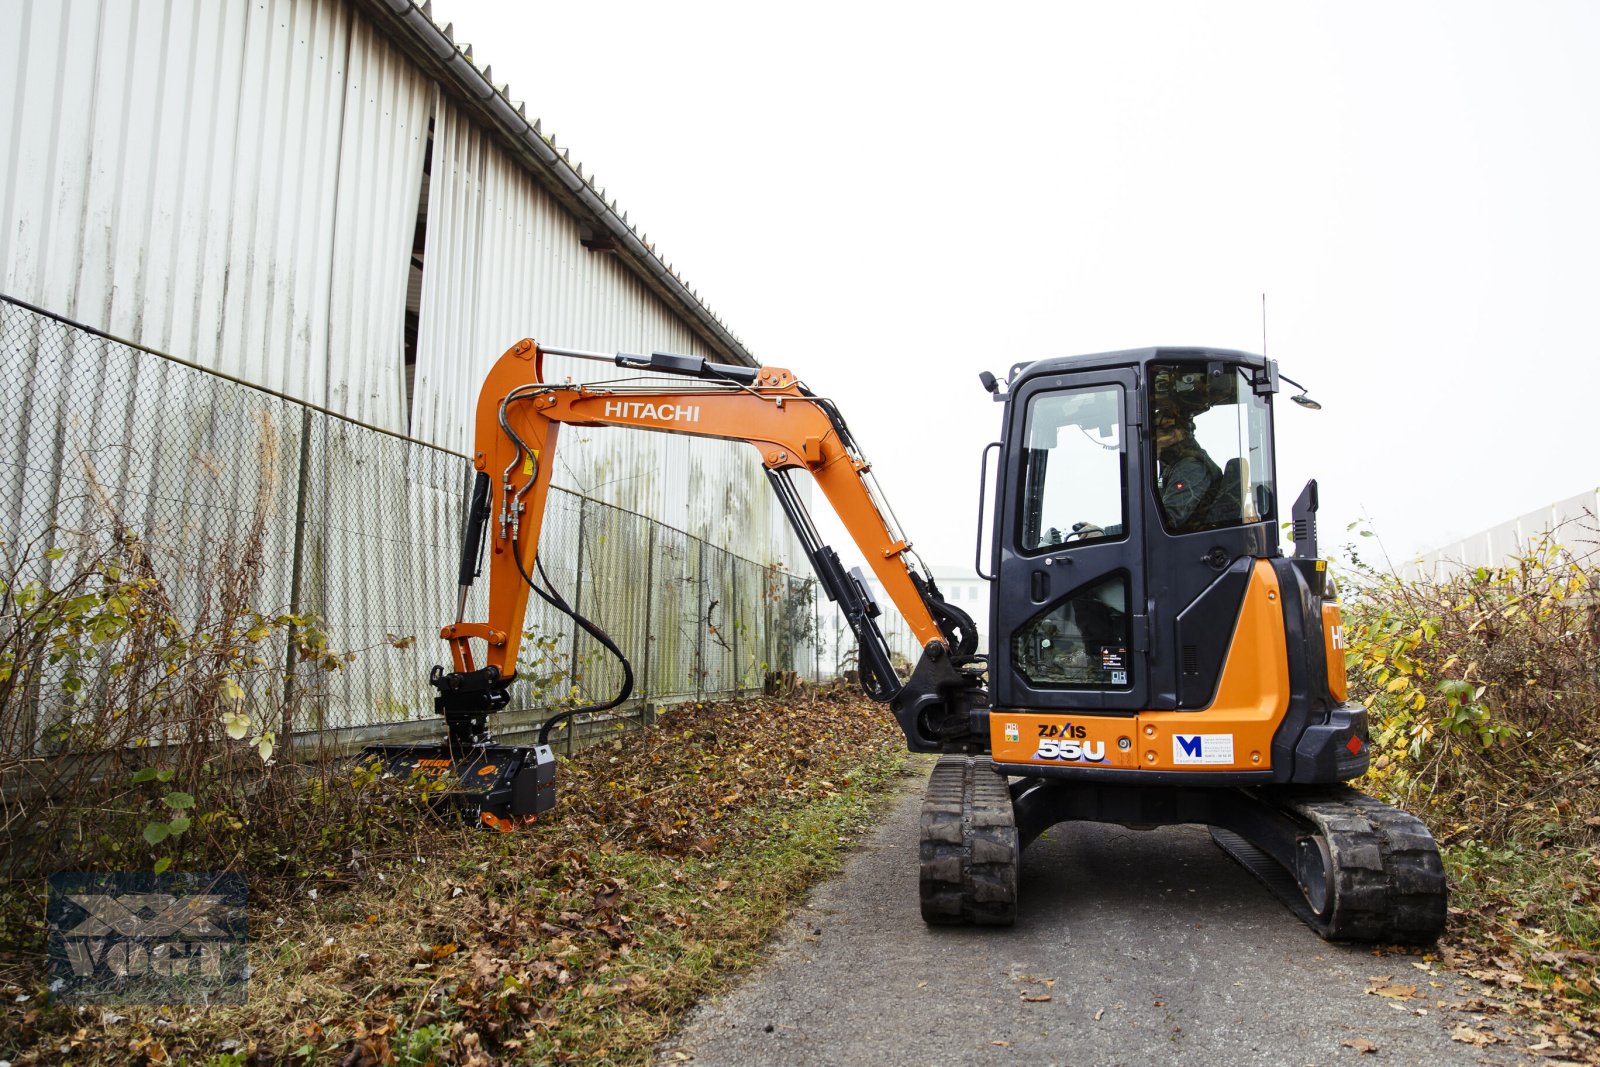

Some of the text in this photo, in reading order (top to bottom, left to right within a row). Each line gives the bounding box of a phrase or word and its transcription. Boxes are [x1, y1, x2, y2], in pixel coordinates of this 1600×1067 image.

[604, 400, 700, 422] HITACHI
[1038, 722, 1087, 739] ZAXIS
[1037, 738, 1106, 762] 55U
